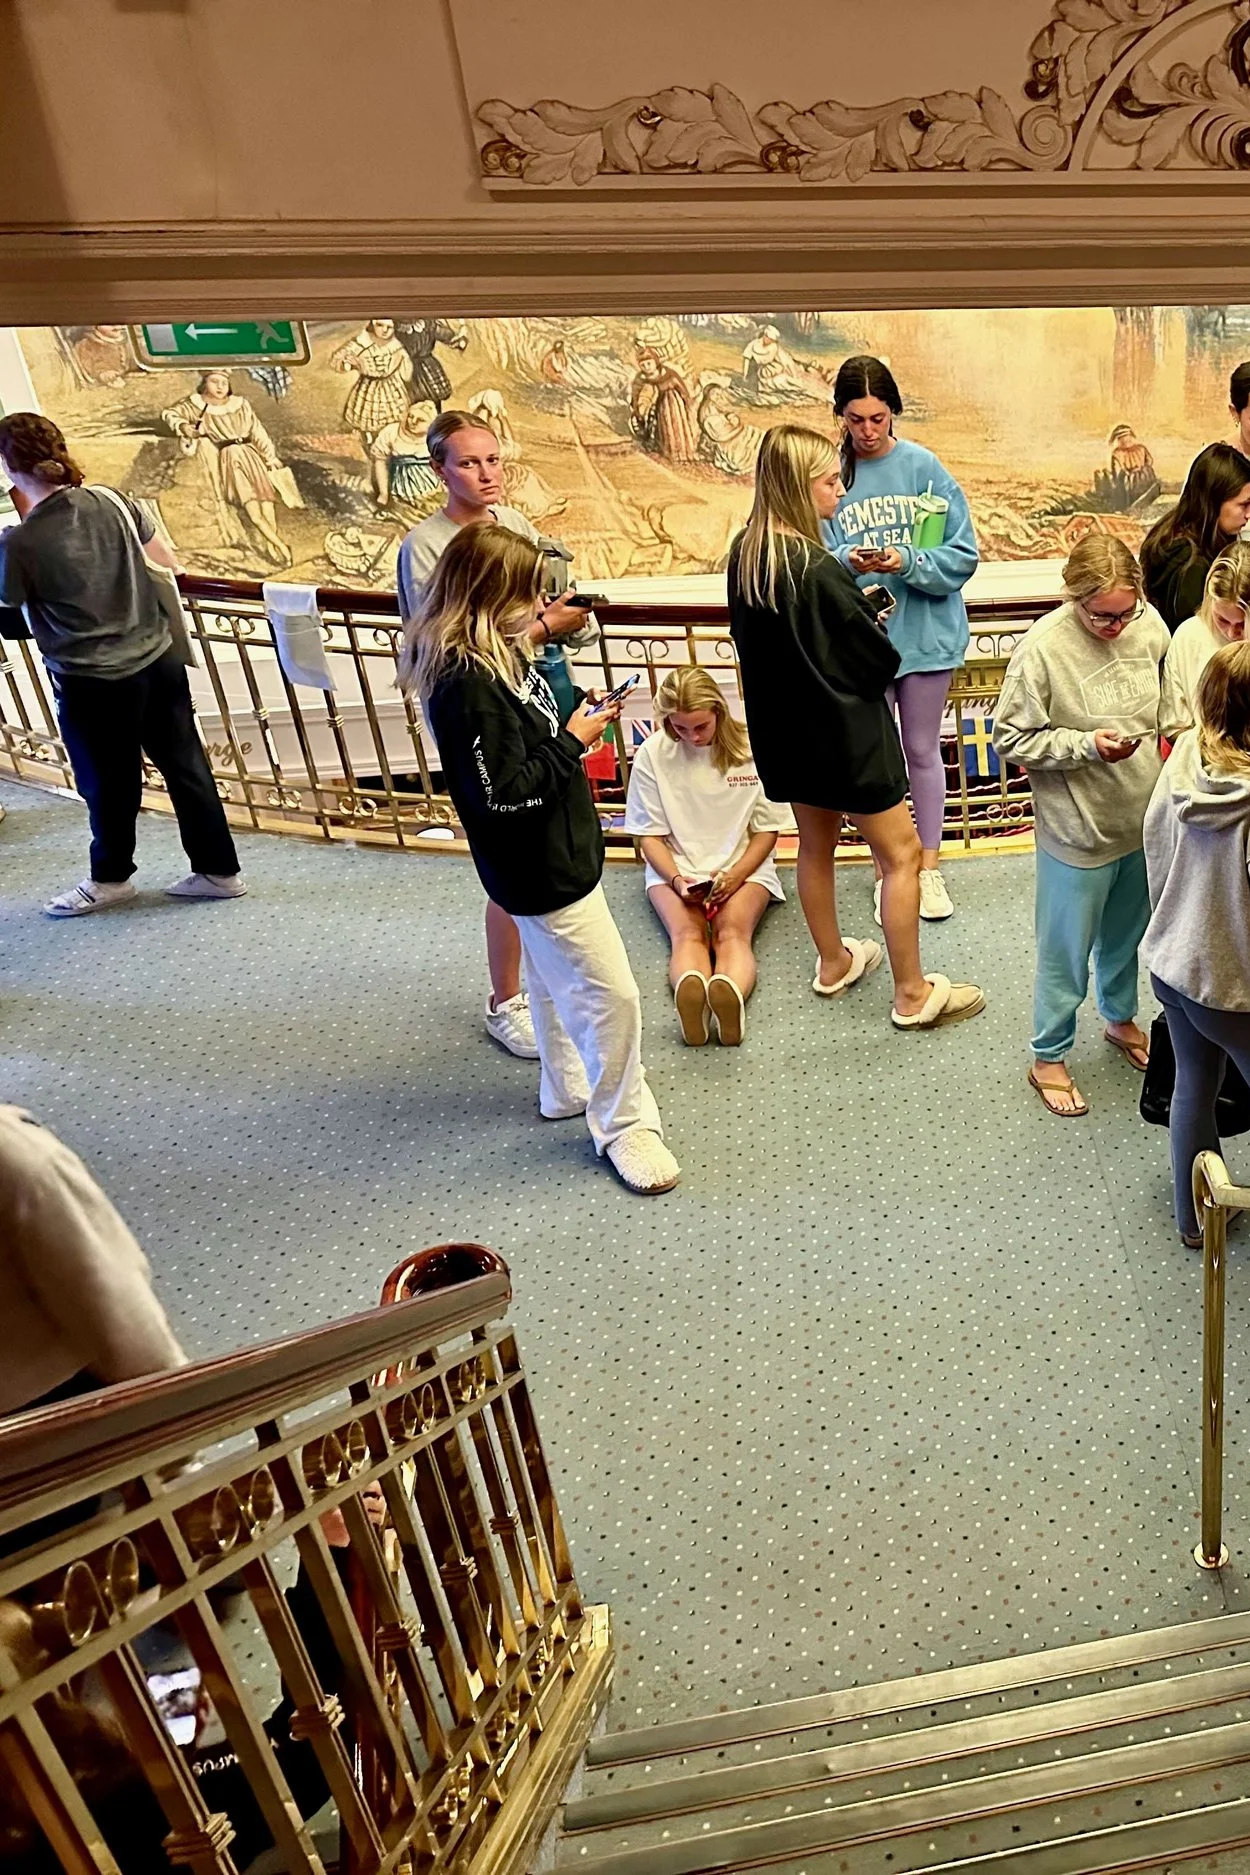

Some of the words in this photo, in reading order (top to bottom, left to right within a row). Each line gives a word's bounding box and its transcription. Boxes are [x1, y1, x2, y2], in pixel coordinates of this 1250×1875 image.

[863, 531, 879, 548] AT
[883, 528, 912, 547] SEA
[474, 749, 491, 785] CAMPUS
[727, 775, 759, 783] GRINGA
[526, 797, 543, 807] THE
